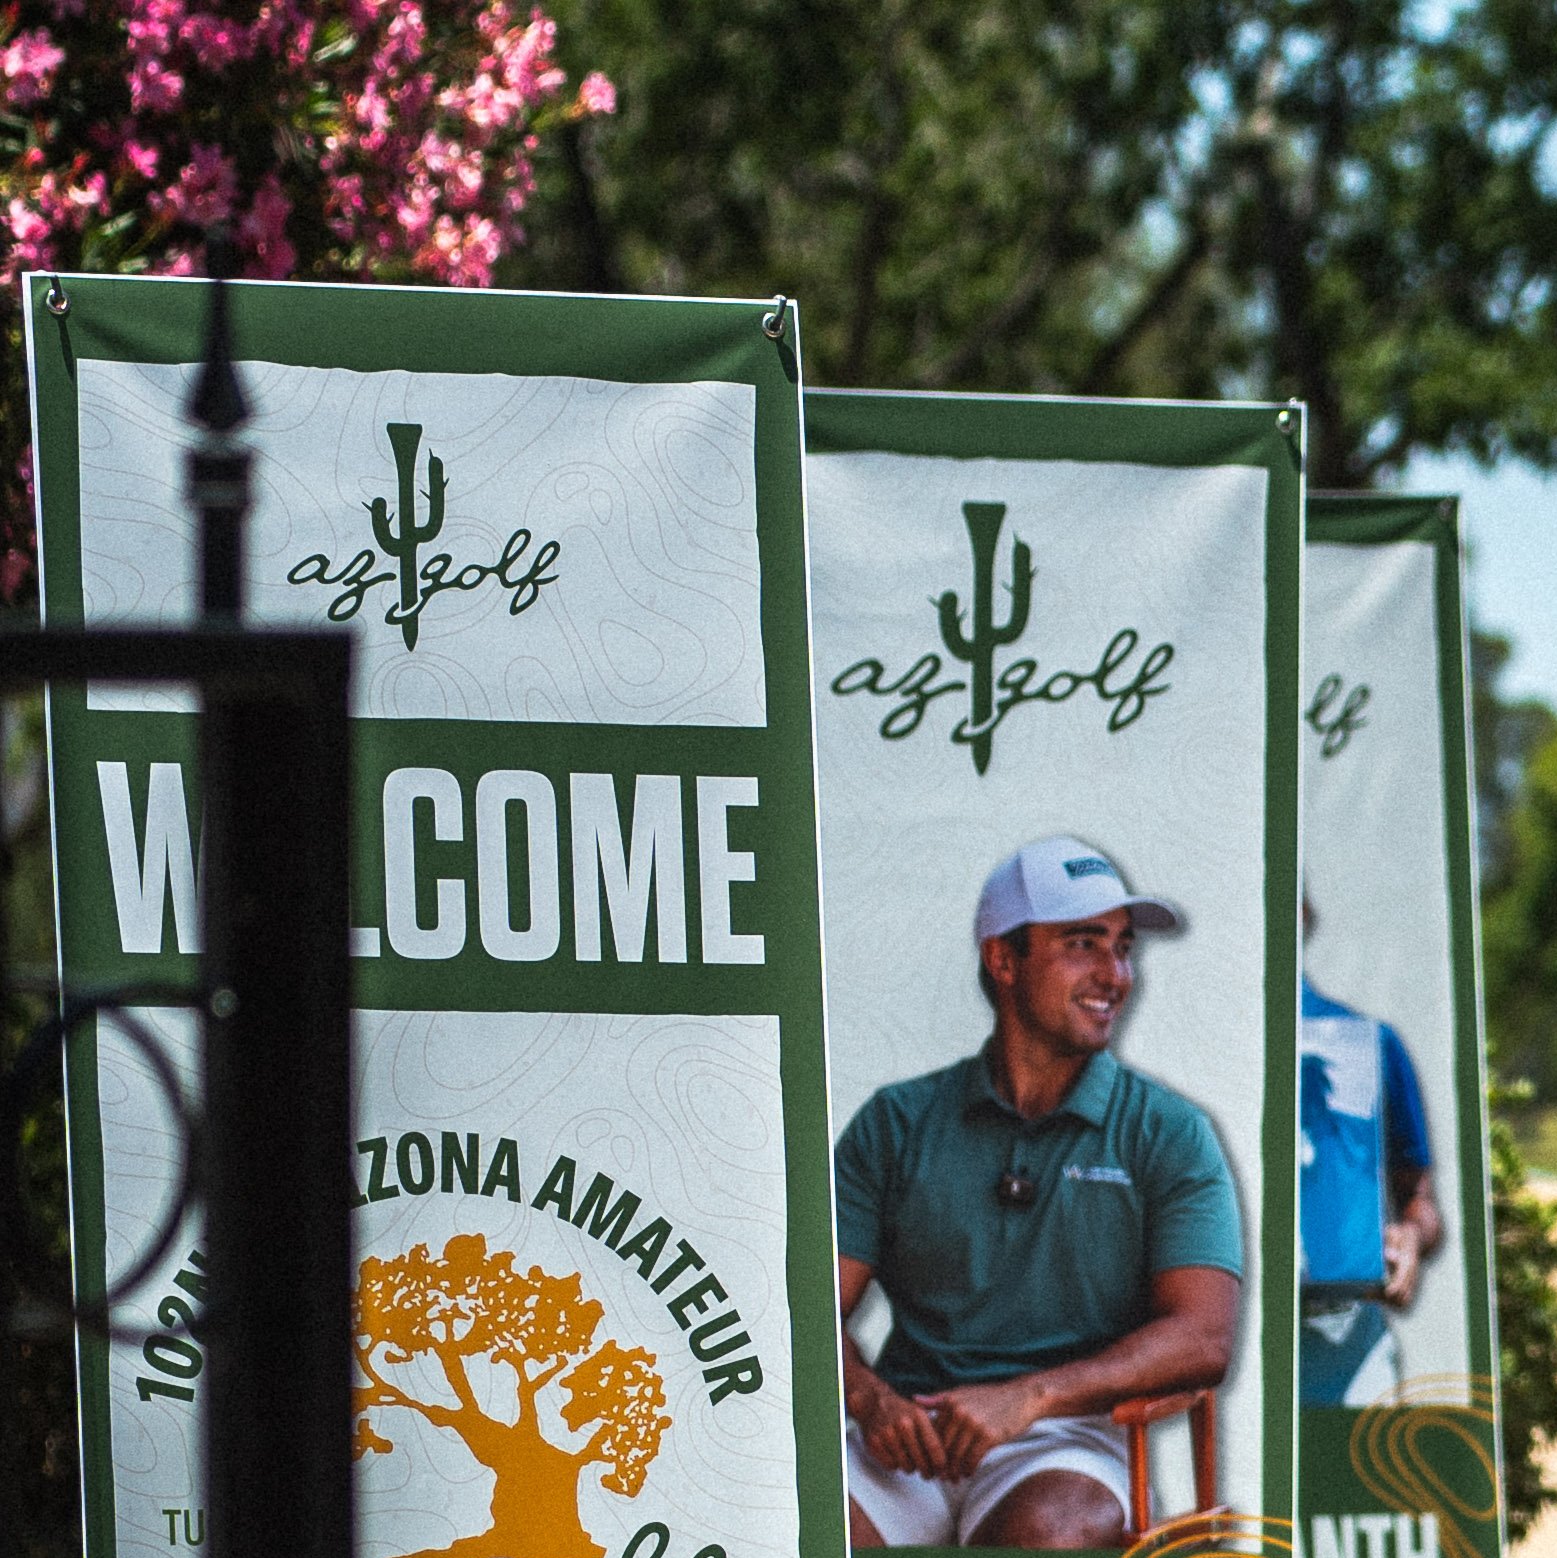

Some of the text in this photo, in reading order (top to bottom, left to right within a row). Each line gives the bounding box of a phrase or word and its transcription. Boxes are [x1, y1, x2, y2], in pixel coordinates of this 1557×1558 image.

[287, 528, 560, 626] az golf
[831, 628, 1175, 745] az golf
[96, 760, 766, 965] WCOME
[352, 1131, 521, 1209] ZONA
[532, 1155, 764, 1406] AMATEUR
